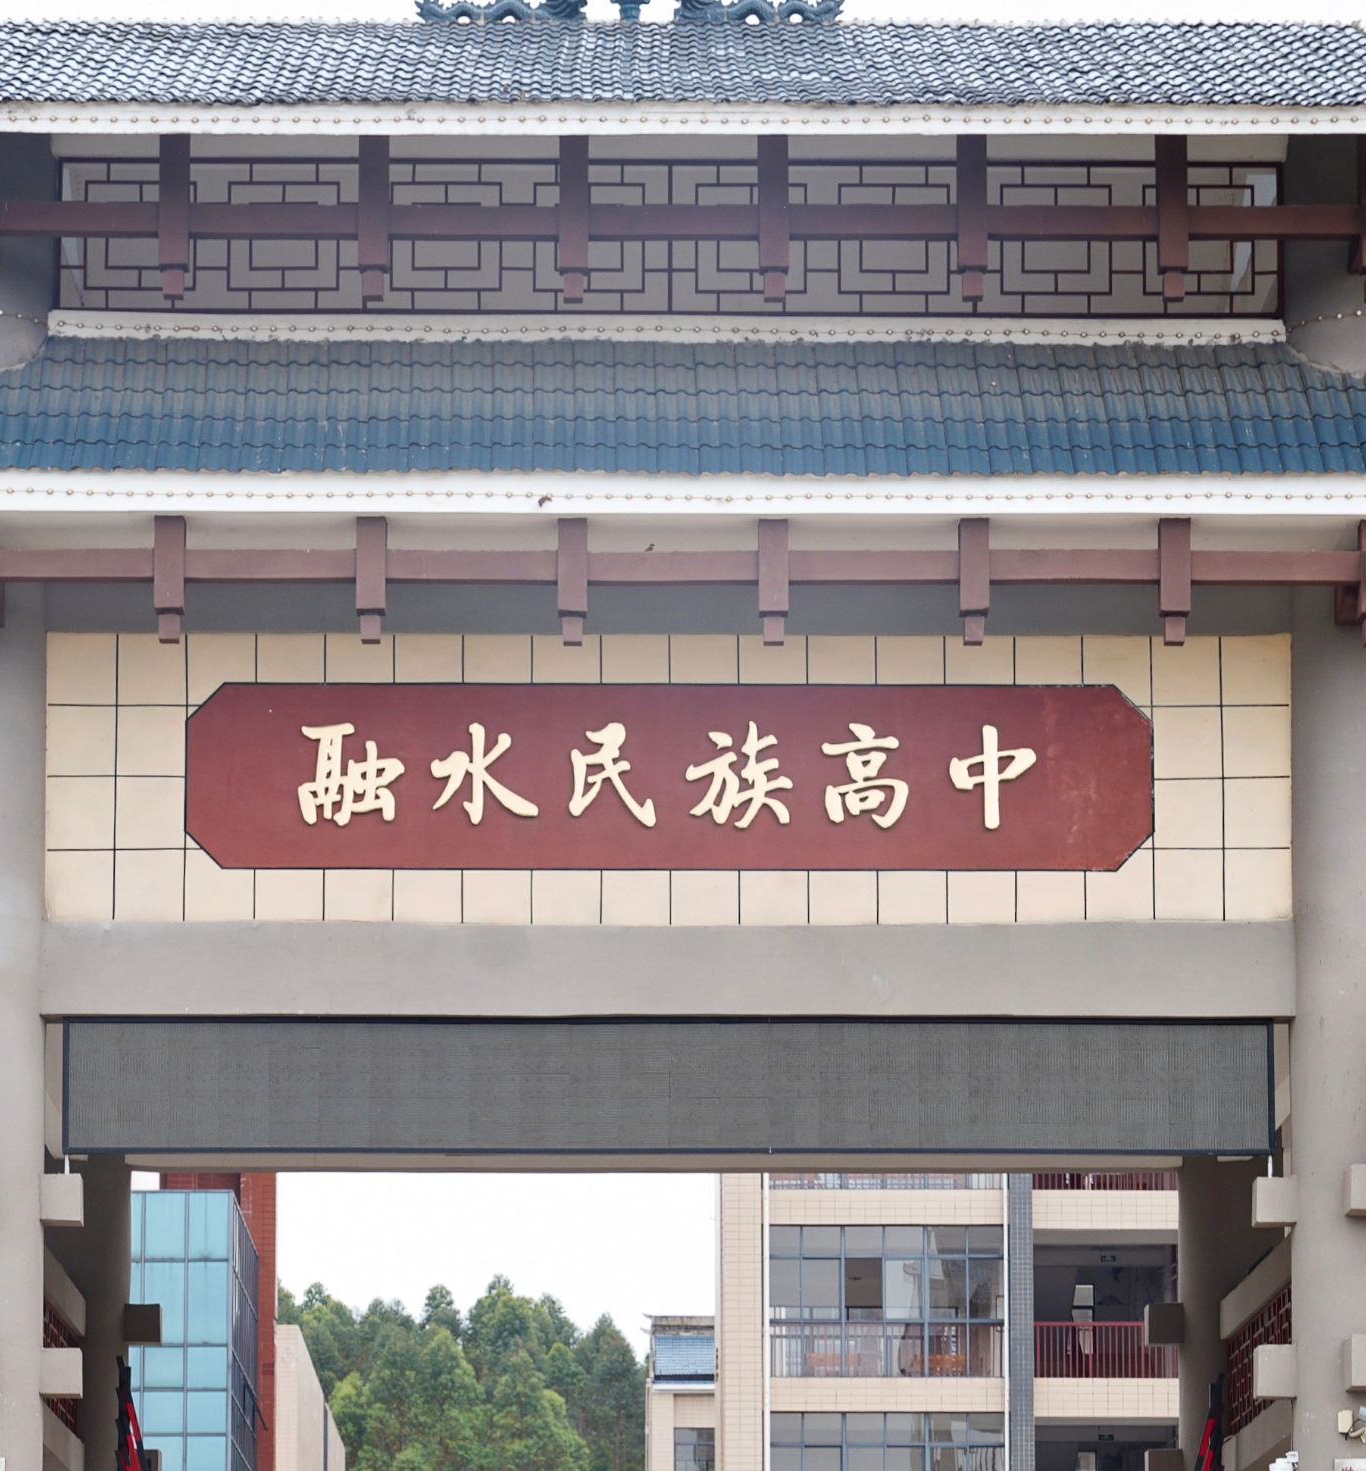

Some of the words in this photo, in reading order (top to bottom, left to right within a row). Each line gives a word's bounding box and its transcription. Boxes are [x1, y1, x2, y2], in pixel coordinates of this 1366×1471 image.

[297, 721, 1037, 830] 融水民族高中
